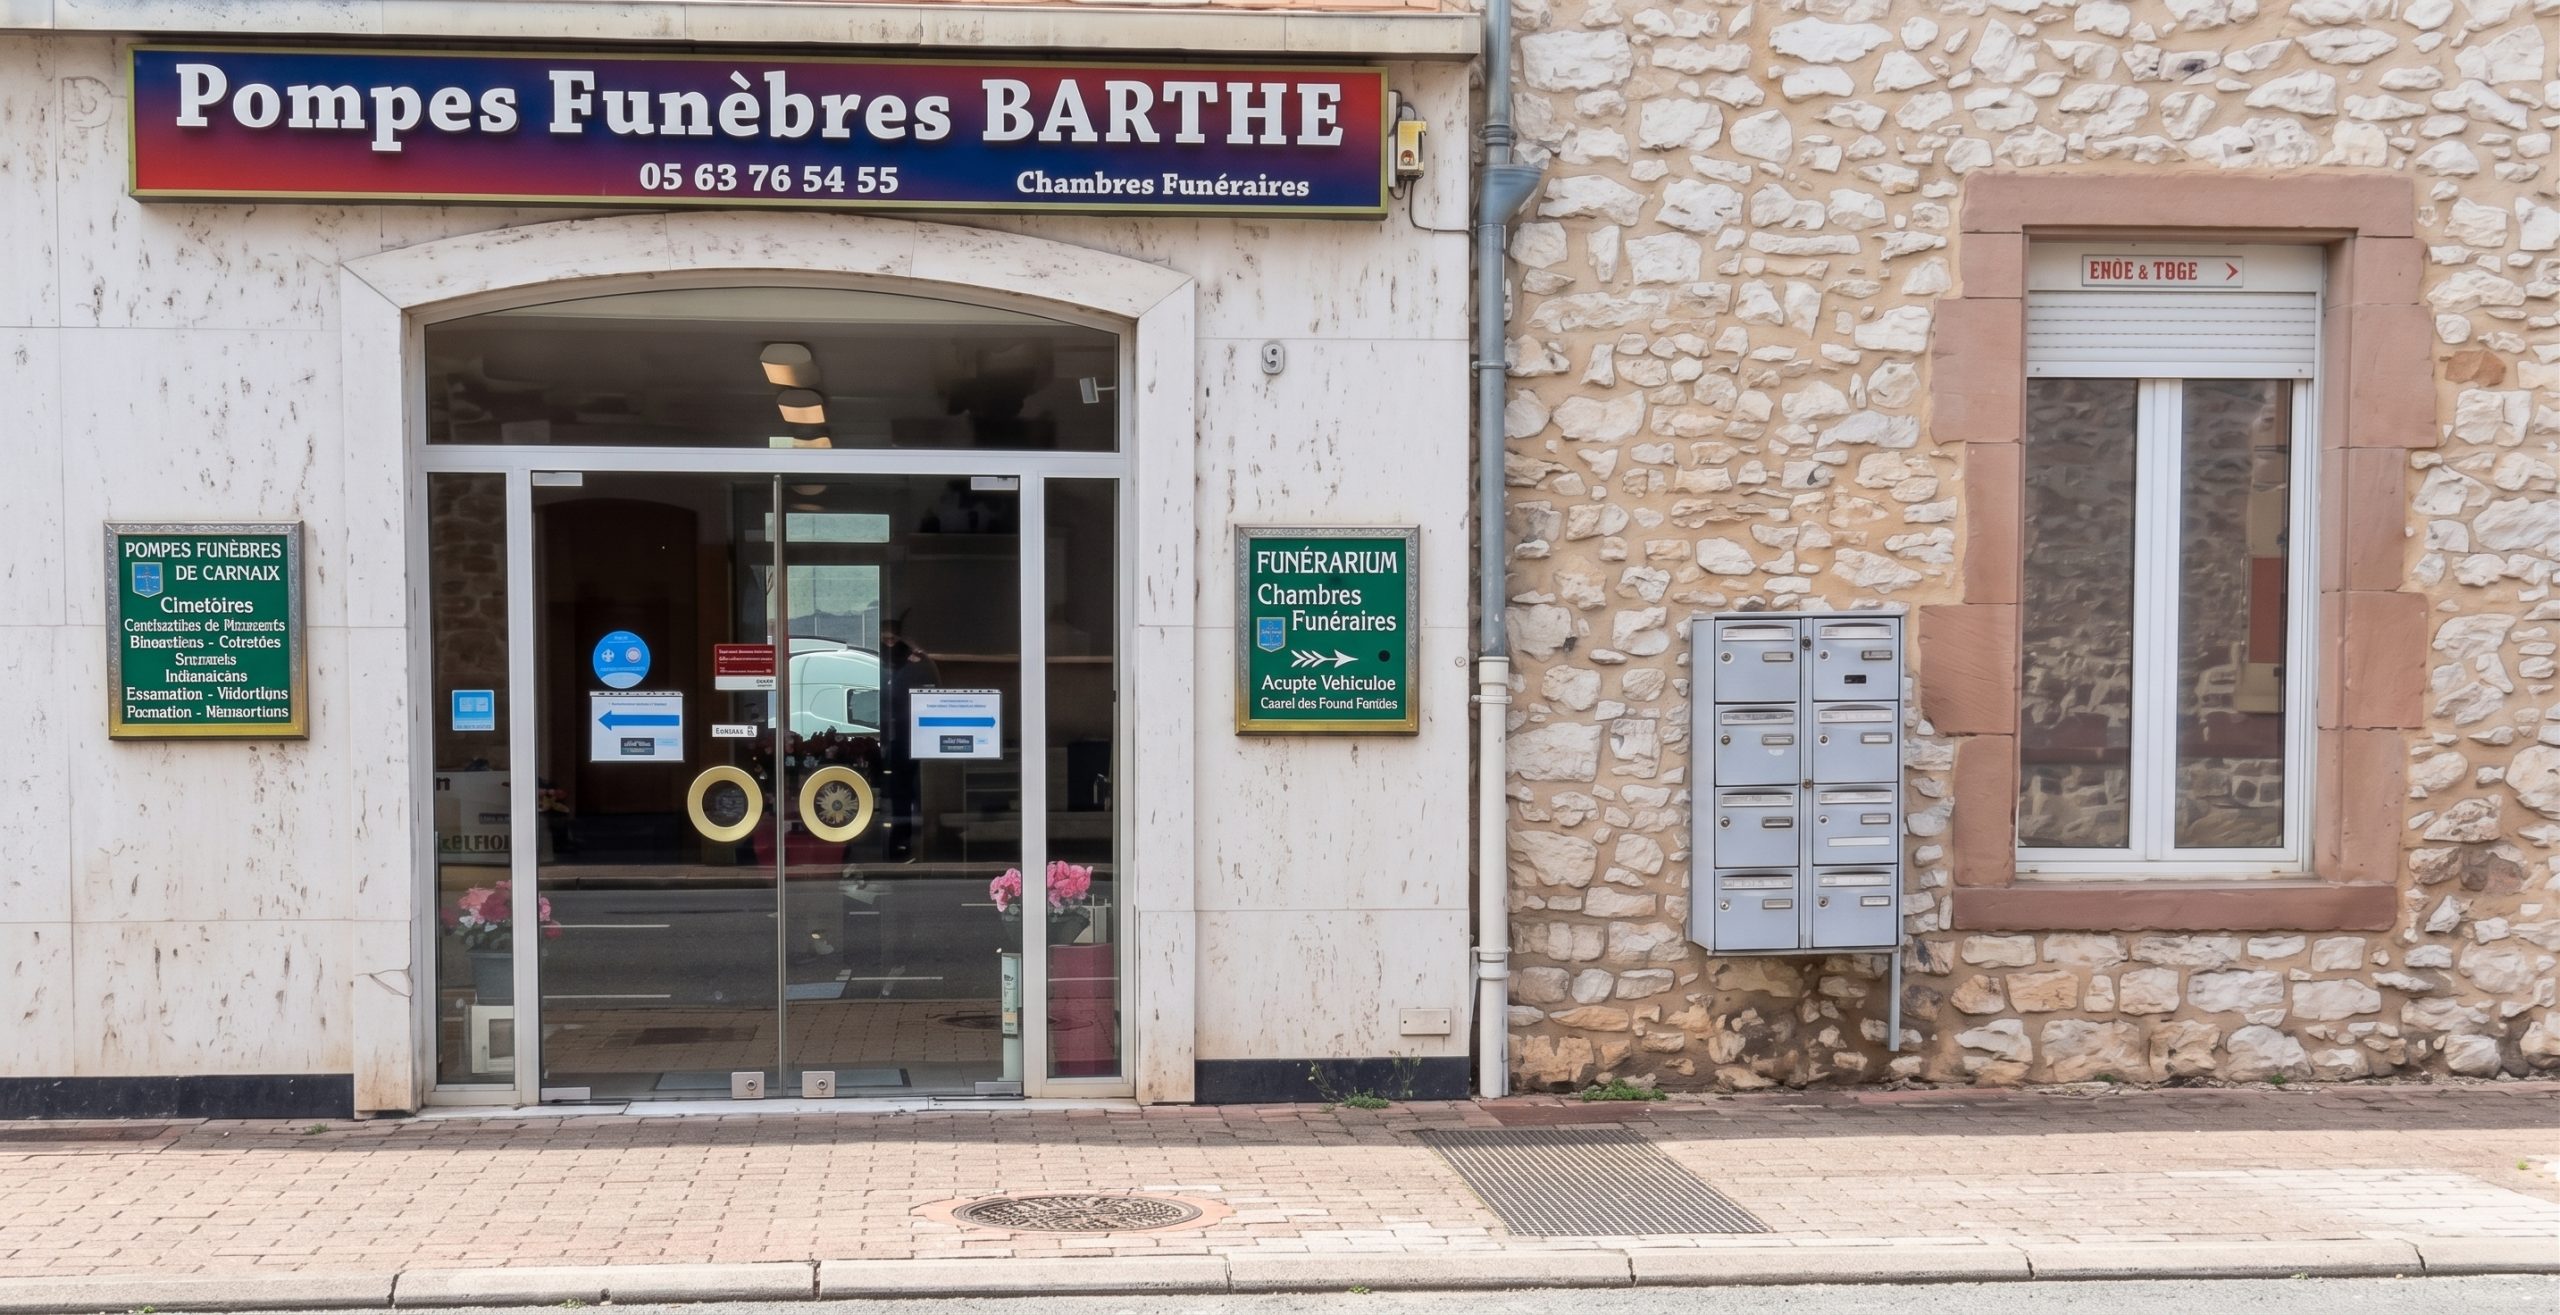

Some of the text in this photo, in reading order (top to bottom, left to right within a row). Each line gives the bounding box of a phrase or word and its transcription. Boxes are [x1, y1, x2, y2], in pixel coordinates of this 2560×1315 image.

[174, 63, 1345, 153] Pompes Funèbres BARTHE
[639, 162, 900, 195] 05 63 76 54 55
[1015, 169, 1311, 198] Chambres Funéraires
[125, 539, 282, 559] POMPES FUNÈBRES
[1256, 546, 1398, 574] FUNÉRARIUM
[175, 565, 281, 581] DE CARNAIX
[1257, 583, 1362, 606] Chambres
[204, 618, 220, 632] de
[1292, 609, 1397, 632] Funéraires
[1261, 674, 1396, 695] Acupte Vehiculoe
[1297, 697, 1317, 710] des
